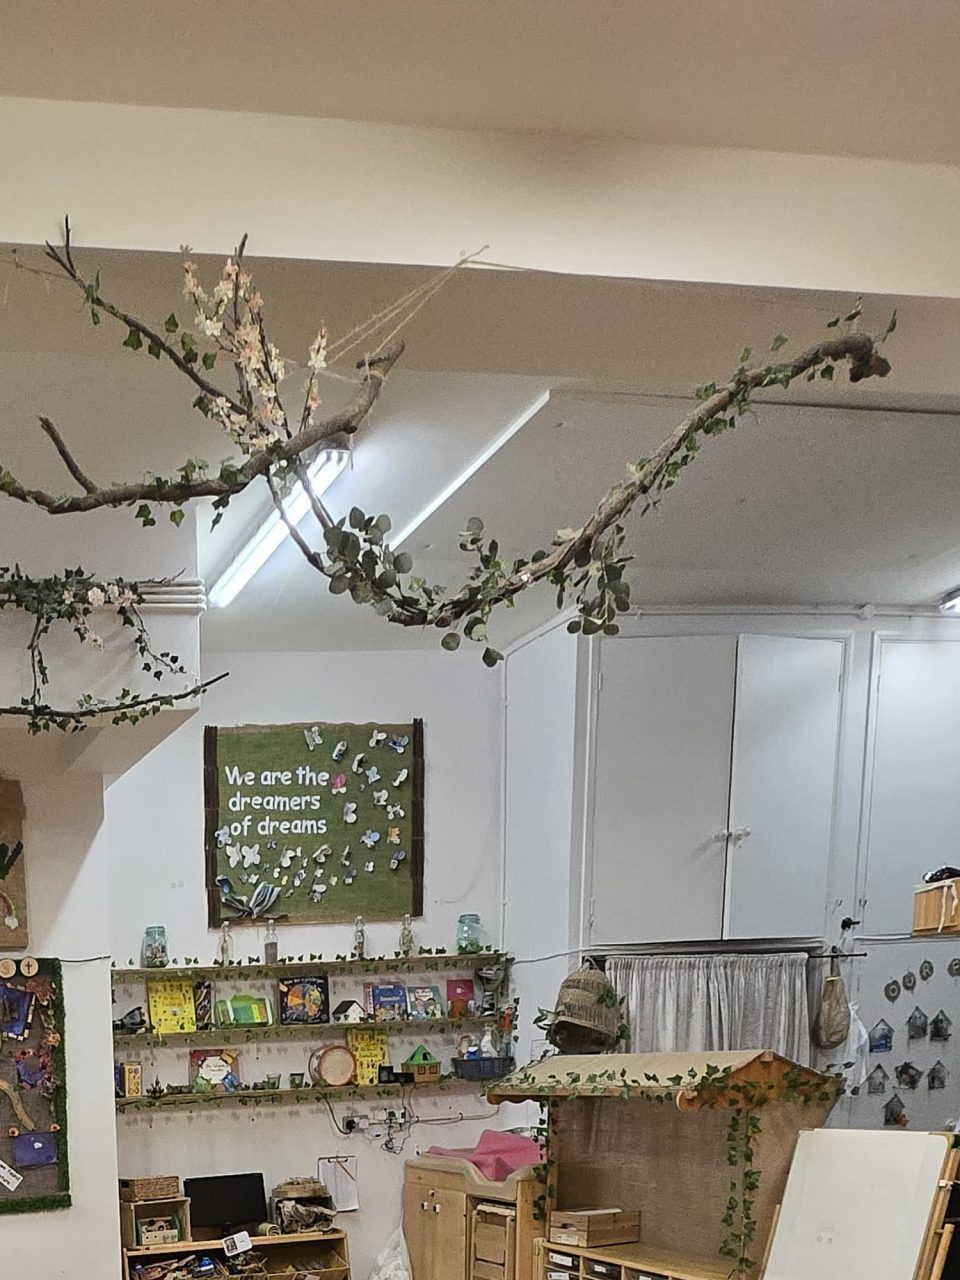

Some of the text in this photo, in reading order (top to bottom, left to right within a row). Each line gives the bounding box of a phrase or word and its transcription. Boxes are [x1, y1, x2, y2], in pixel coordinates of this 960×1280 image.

[224, 765, 330, 786] We are the
[228, 791, 321, 812] dreamers
[230, 815, 327, 837] of dreams
